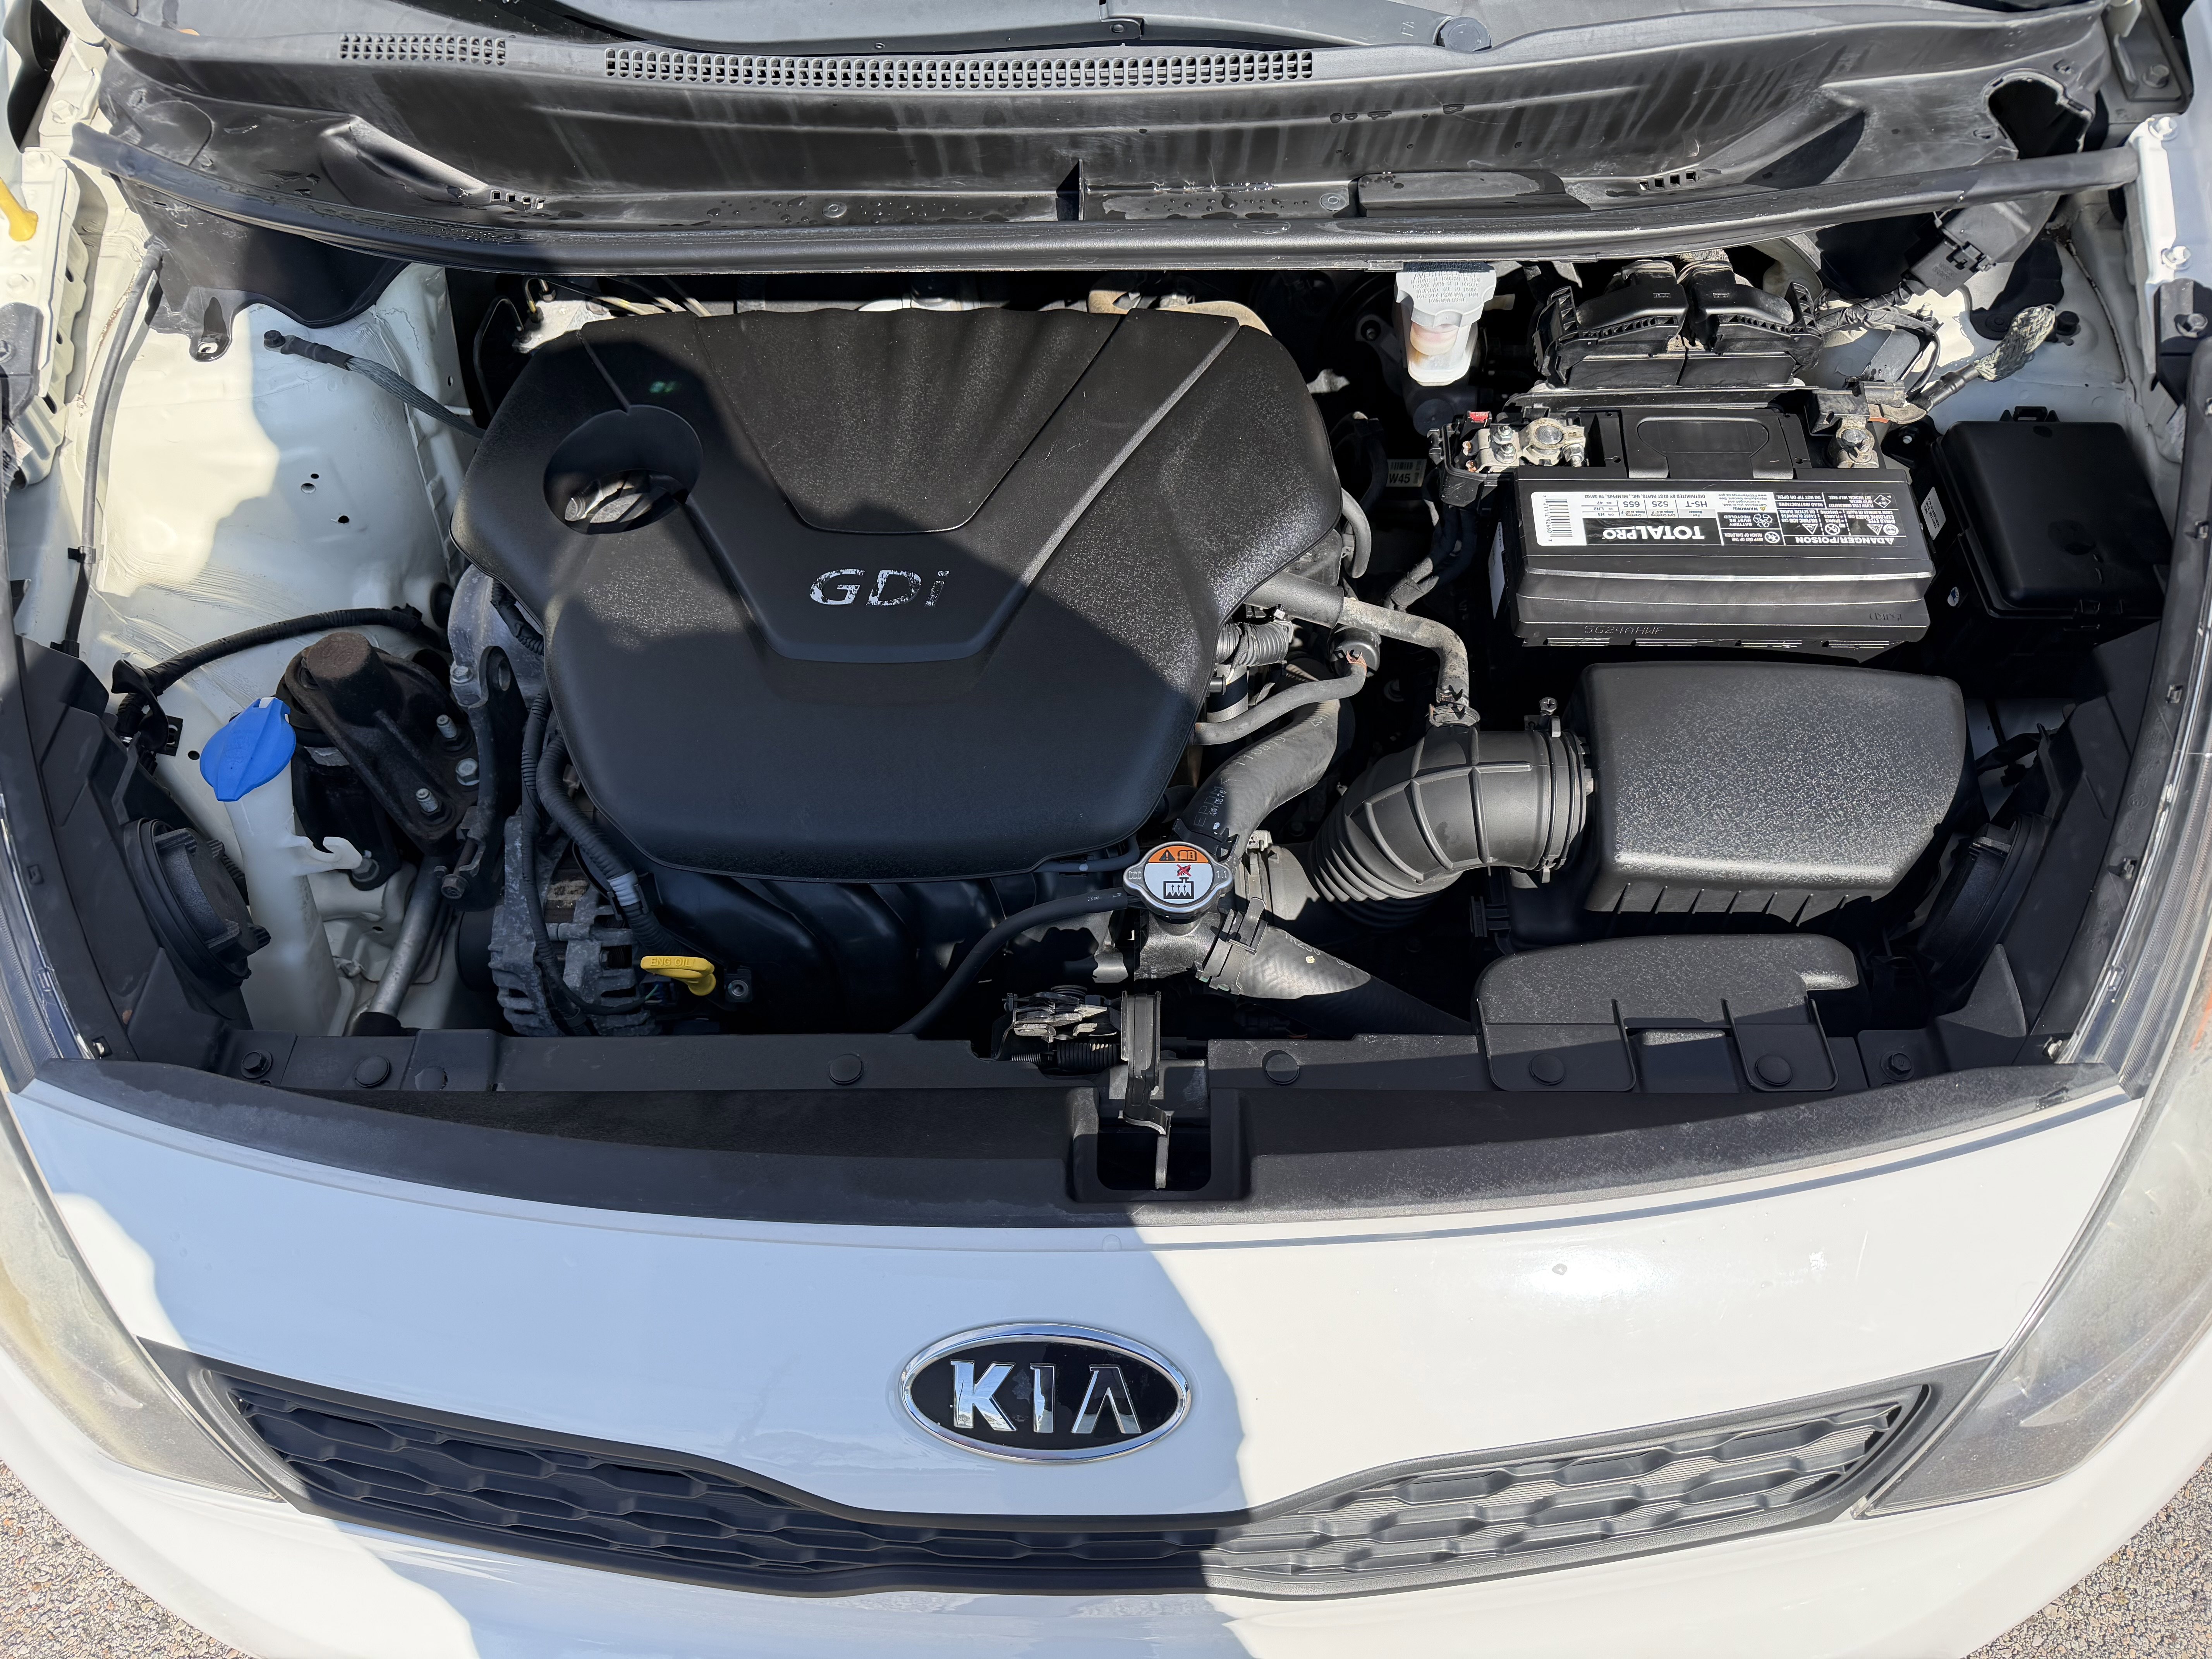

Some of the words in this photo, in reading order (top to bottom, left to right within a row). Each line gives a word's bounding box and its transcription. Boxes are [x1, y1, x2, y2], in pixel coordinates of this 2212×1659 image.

[1389, 473, 1410, 484] W45
[1602, 526, 1705, 540] TOTALPRO
[810, 568, 950, 607] GDi
[1216, 870, 1227, 879] 1.1
[651, 957, 671, 966] ENG
[674, 958, 692, 968] OIL
[950, 1359, 1143, 1434] KIA
